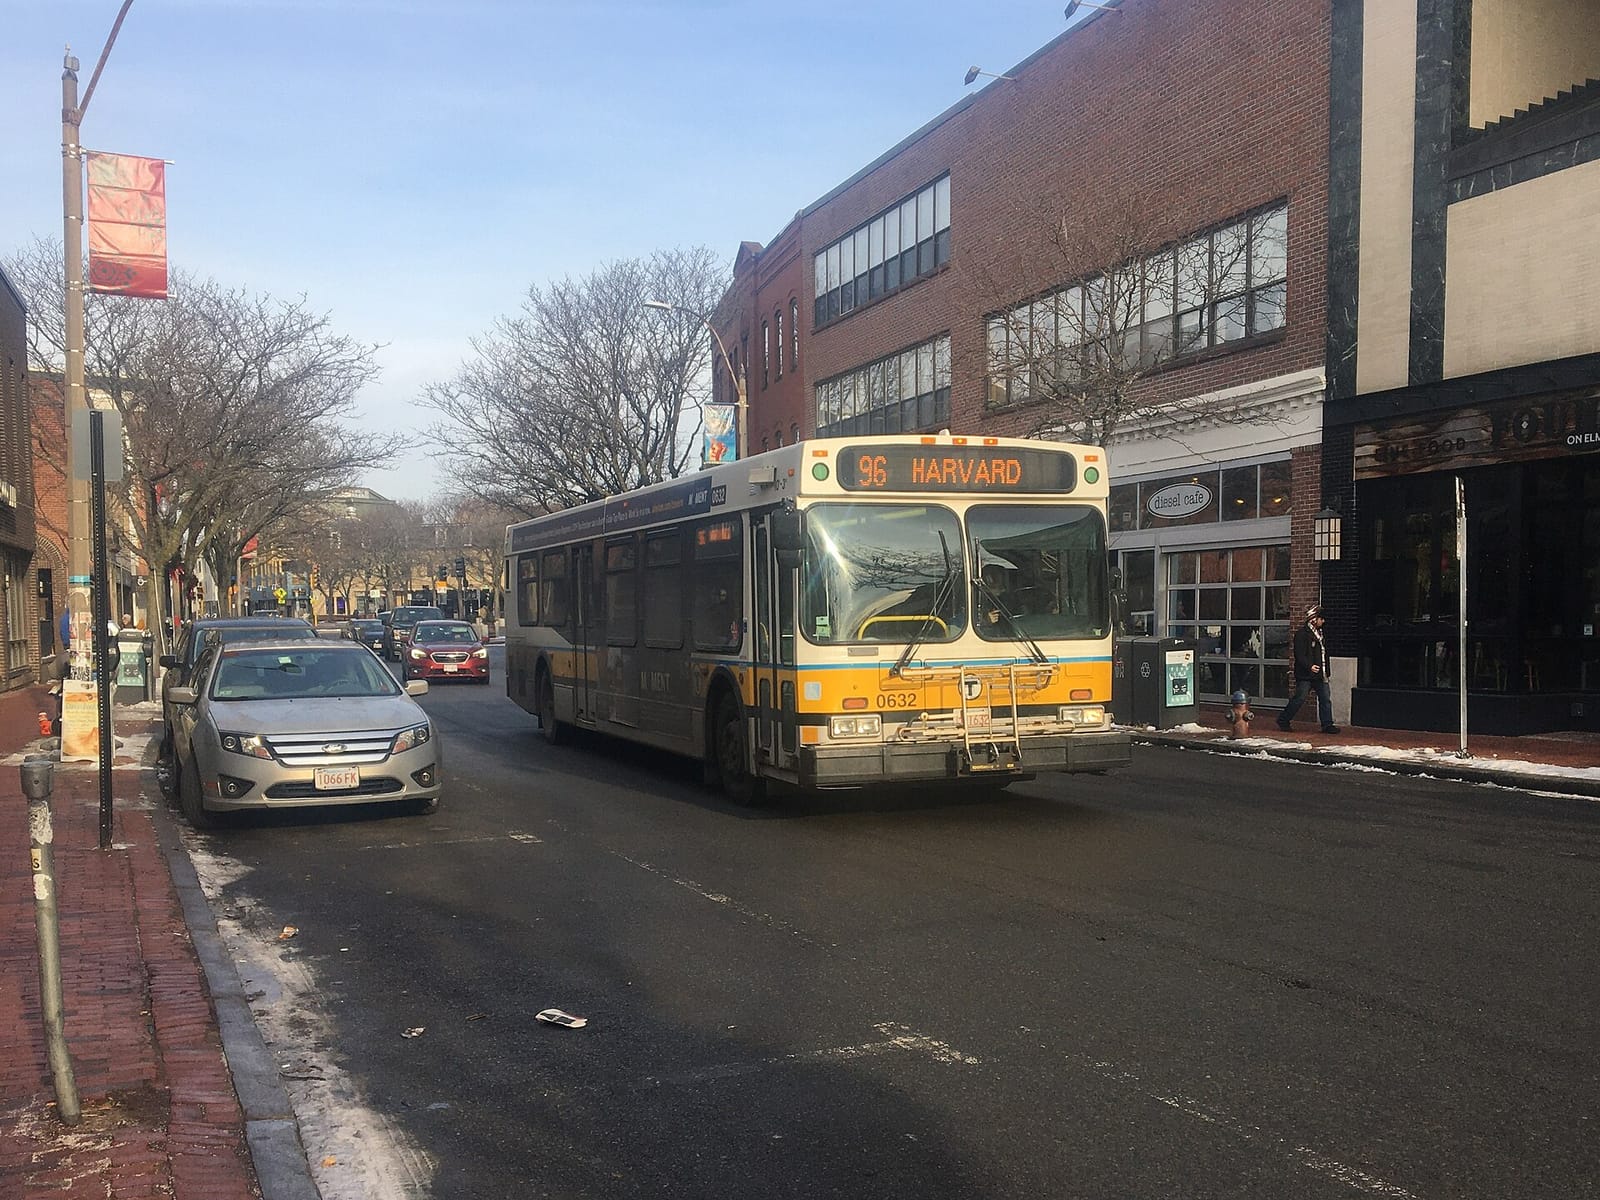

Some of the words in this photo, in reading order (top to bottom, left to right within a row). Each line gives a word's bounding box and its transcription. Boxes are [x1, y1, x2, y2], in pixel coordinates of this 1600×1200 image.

[1566, 434, 1583, 445] ON
[858, 455, 888, 486] 96
[912, 458, 1022, 484] HARVARD
[1154, 493, 1181, 510] diesel
[964, 680, 978, 697] T
[876, 692, 917, 708] 0632
[318, 773, 342, 785] 1066
[344, 772, 357, 784] FK
